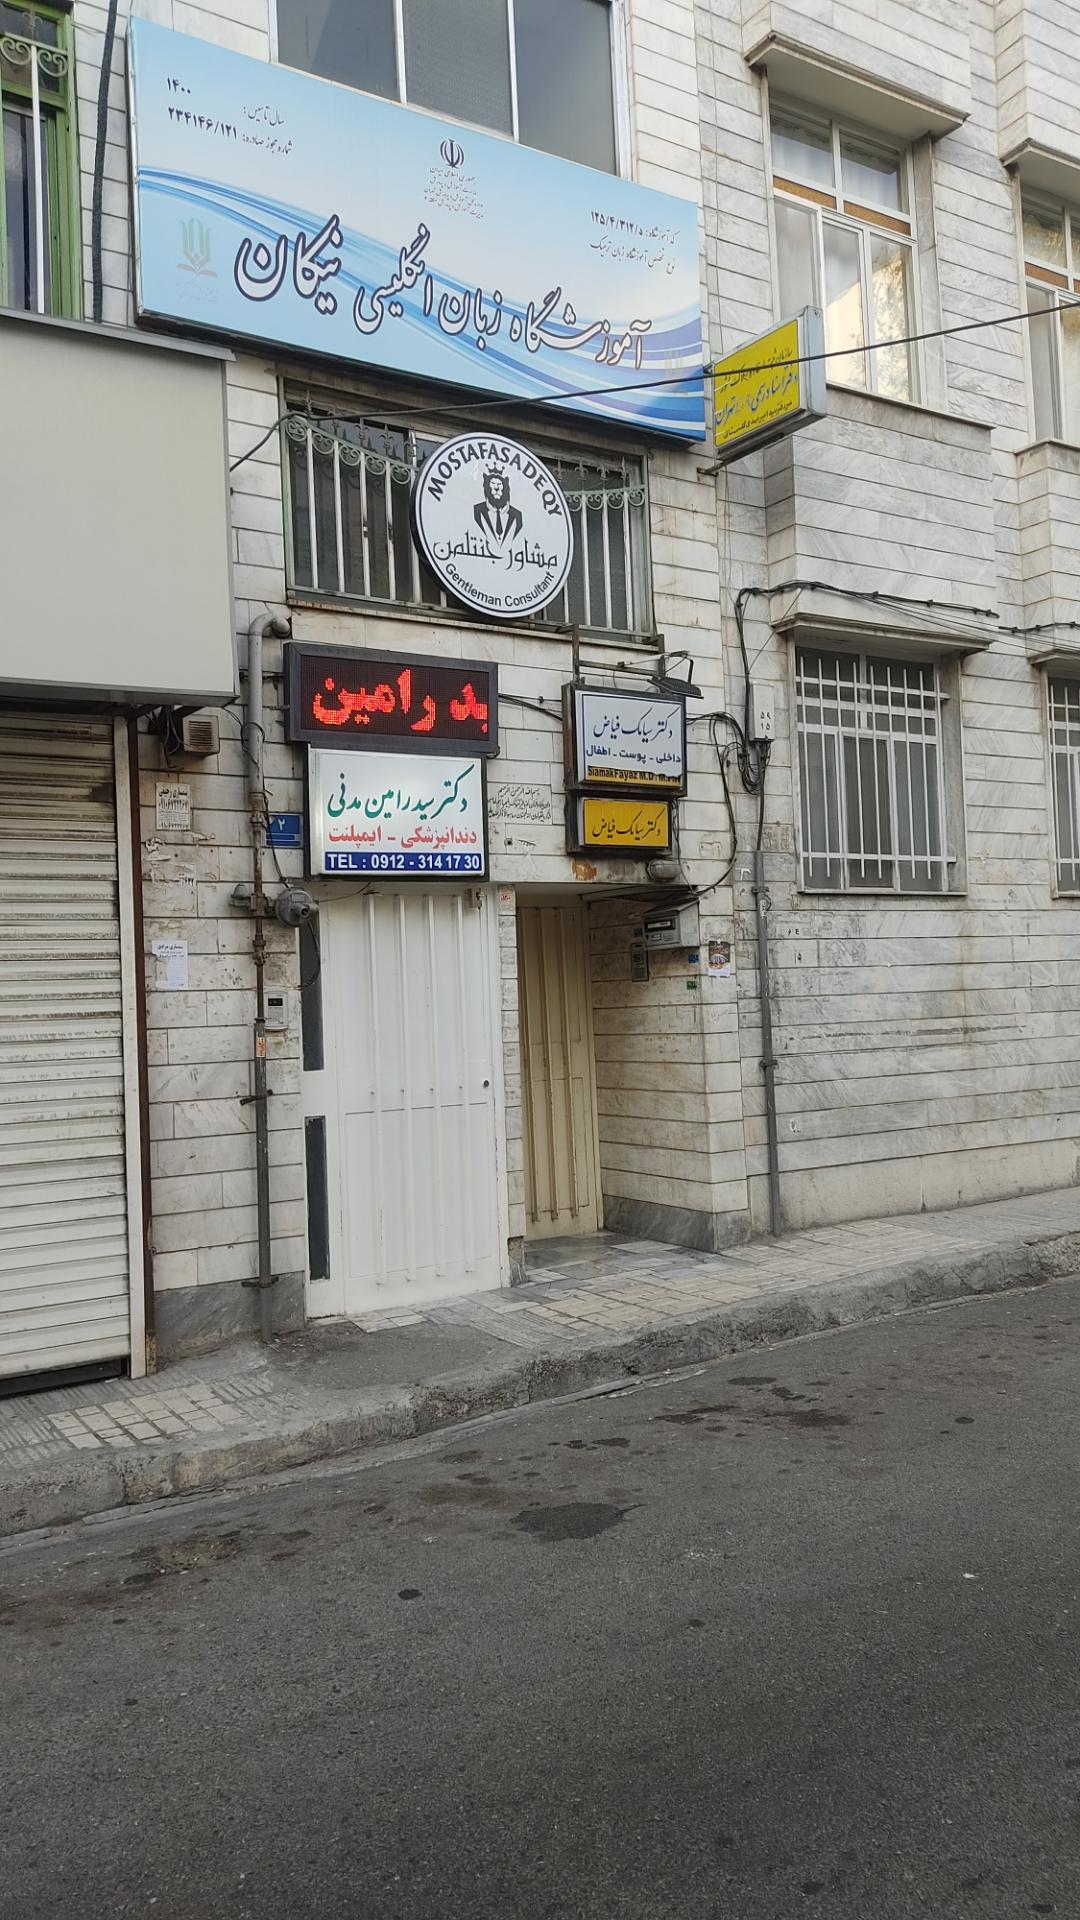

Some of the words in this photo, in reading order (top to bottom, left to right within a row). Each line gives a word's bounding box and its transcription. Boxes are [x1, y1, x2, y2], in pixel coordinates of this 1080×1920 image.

[166, 77, 191, 94] ۱۴۰۰
[234, 214, 343, 315] نیکان
[353, 222, 433, 335] انگلیسی
[438, 287, 502, 350] زبان
[510, 287, 651, 370] آموزشگاه
[433, 529, 504, 564] جنتلمن
[505, 536, 558, 572] مشاور
[445, 563, 502, 607] Gentleman
[504, 570, 555, 607] Consultant
[313, 668, 436, 732] رامین
[593, 715, 620, 740] فیاض
[621, 706, 653, 743] سیامک
[651, 706, 680, 742] دکتر
[586, 745, 611, 758] اطفال
[619, 749, 647, 765] پوست
[655, 752, 681, 764] داخلی
[327, 772, 362, 818] مدنی
[364, 788, 411, 819] رامین
[430, 763, 475, 819] دکتر
[278, 818, 286, 831] ۲
[411, 797, 435, 821] سید
[643, 808, 666, 839] دکتر
[328, 825, 382, 848] ایمپلنت
[401, 825, 478, 850] دندانپزشکی
[328, 854, 357, 869] TEL
[371, 855, 405, 869] 0912
[418, 855, 443, 870] 314
[445, 855, 461, 870] 17
[464, 855, 480, 870] 30
